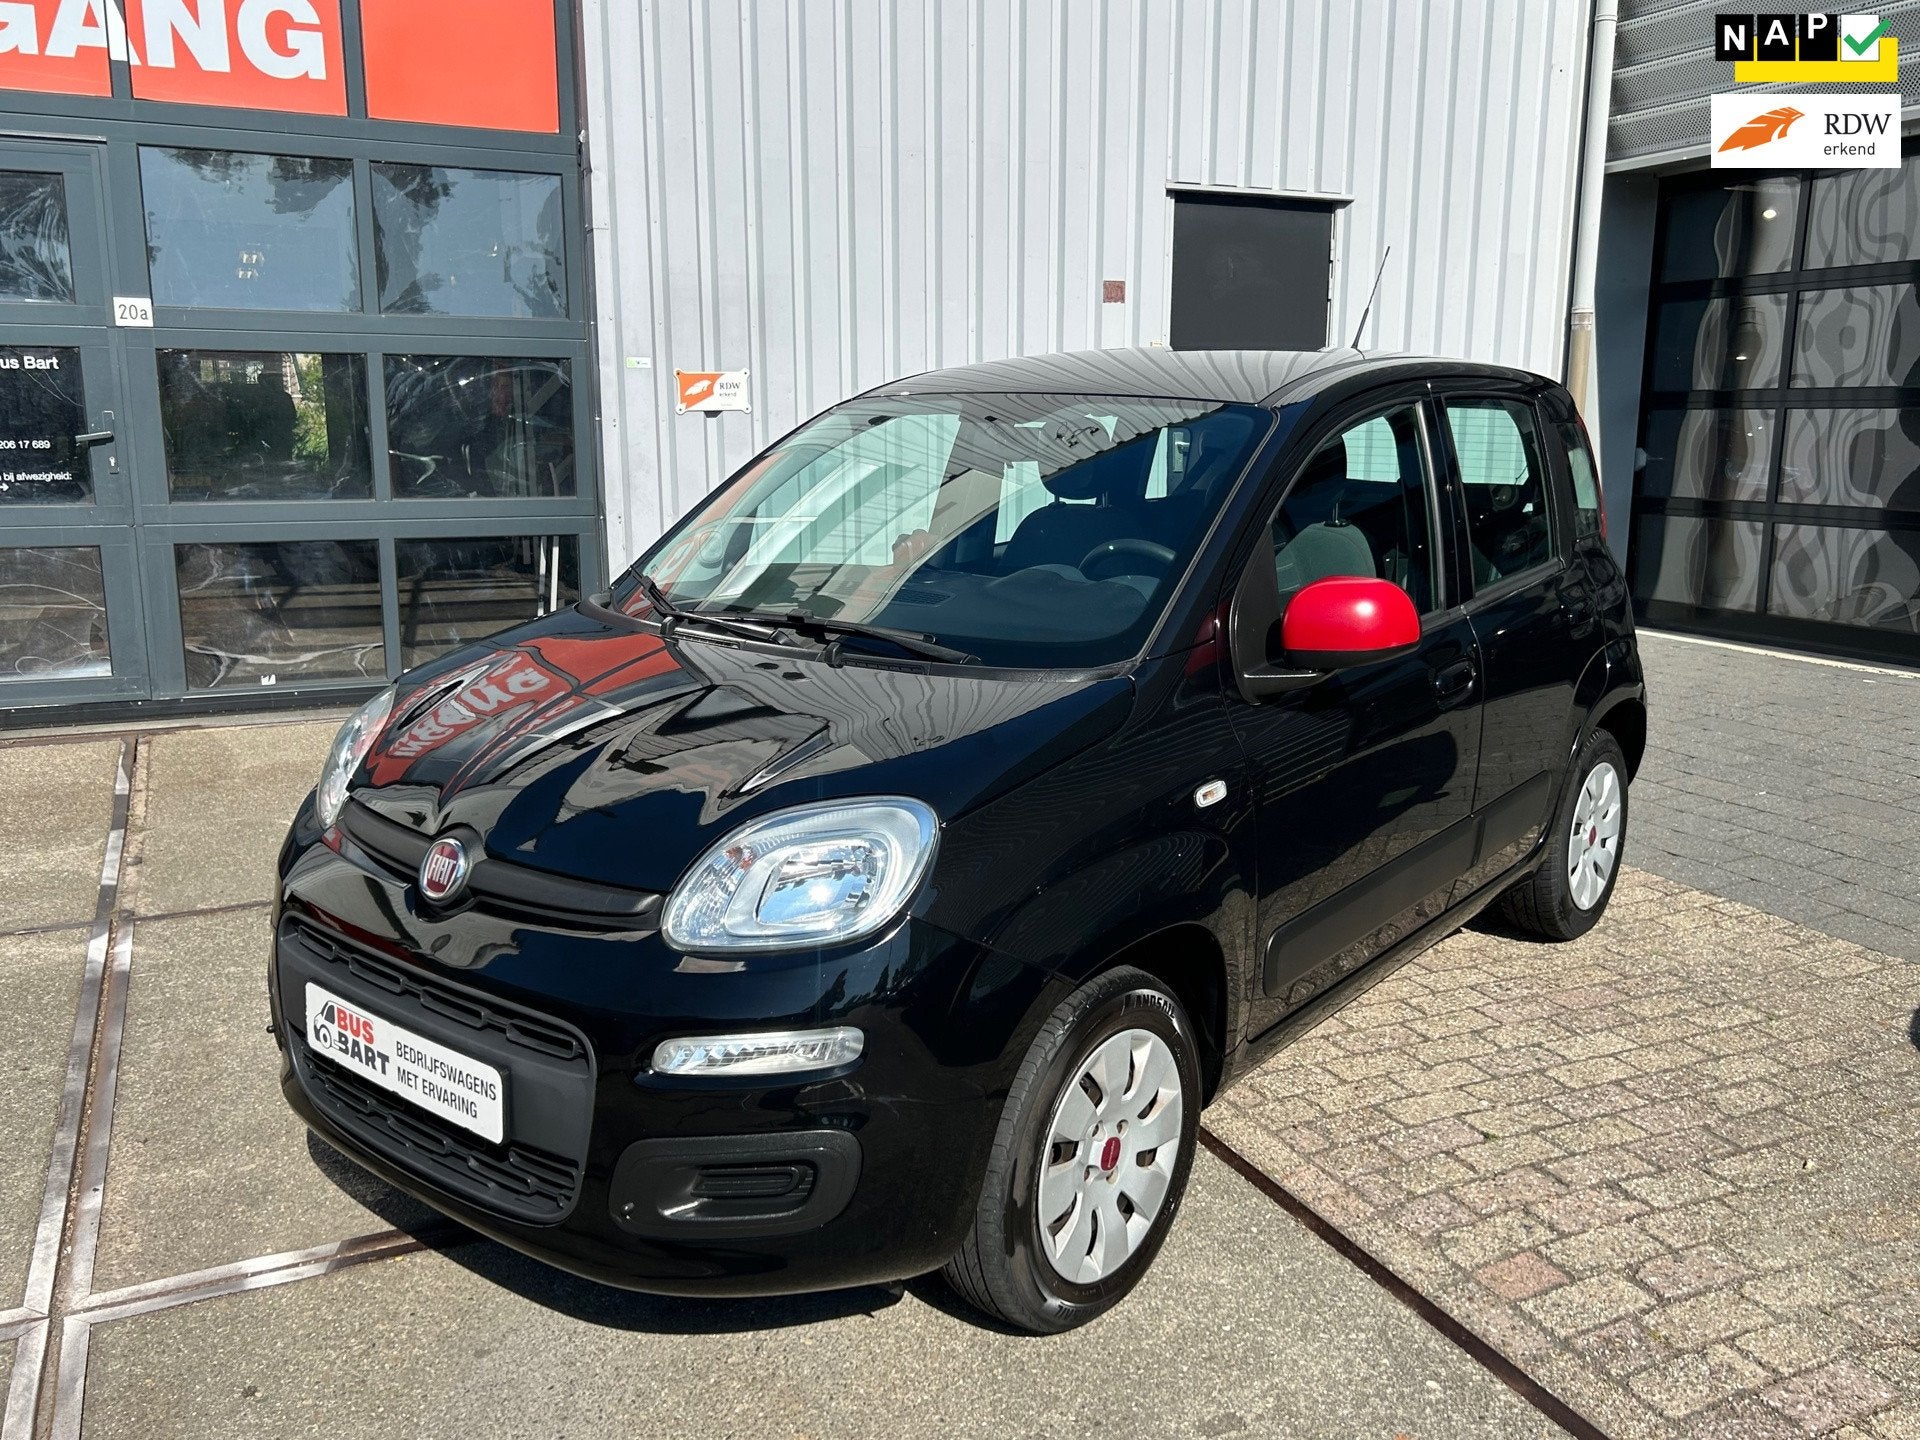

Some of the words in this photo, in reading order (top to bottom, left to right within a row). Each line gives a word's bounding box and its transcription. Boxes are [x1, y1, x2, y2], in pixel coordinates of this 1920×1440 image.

[118, 304, 149, 320] 20a
[23, 355, 60, 370] Bart
[719, 382, 741, 390] RDW
[18, 440, 30, 450] 17
[32, 440, 51, 450] 689
[3, 472, 15, 483] bij
[16, 471, 73, 483] afwezigheid:
[427, 853, 457, 886] FIAT
[336, 1007, 375, 1045] BUS
[336, 1031, 390, 1076] BART
[396, 1040, 497, 1101] BEDRIJFSWAGENS
[397, 1066, 419, 1091] MET
[422, 1078, 478, 1119] ERVARING
